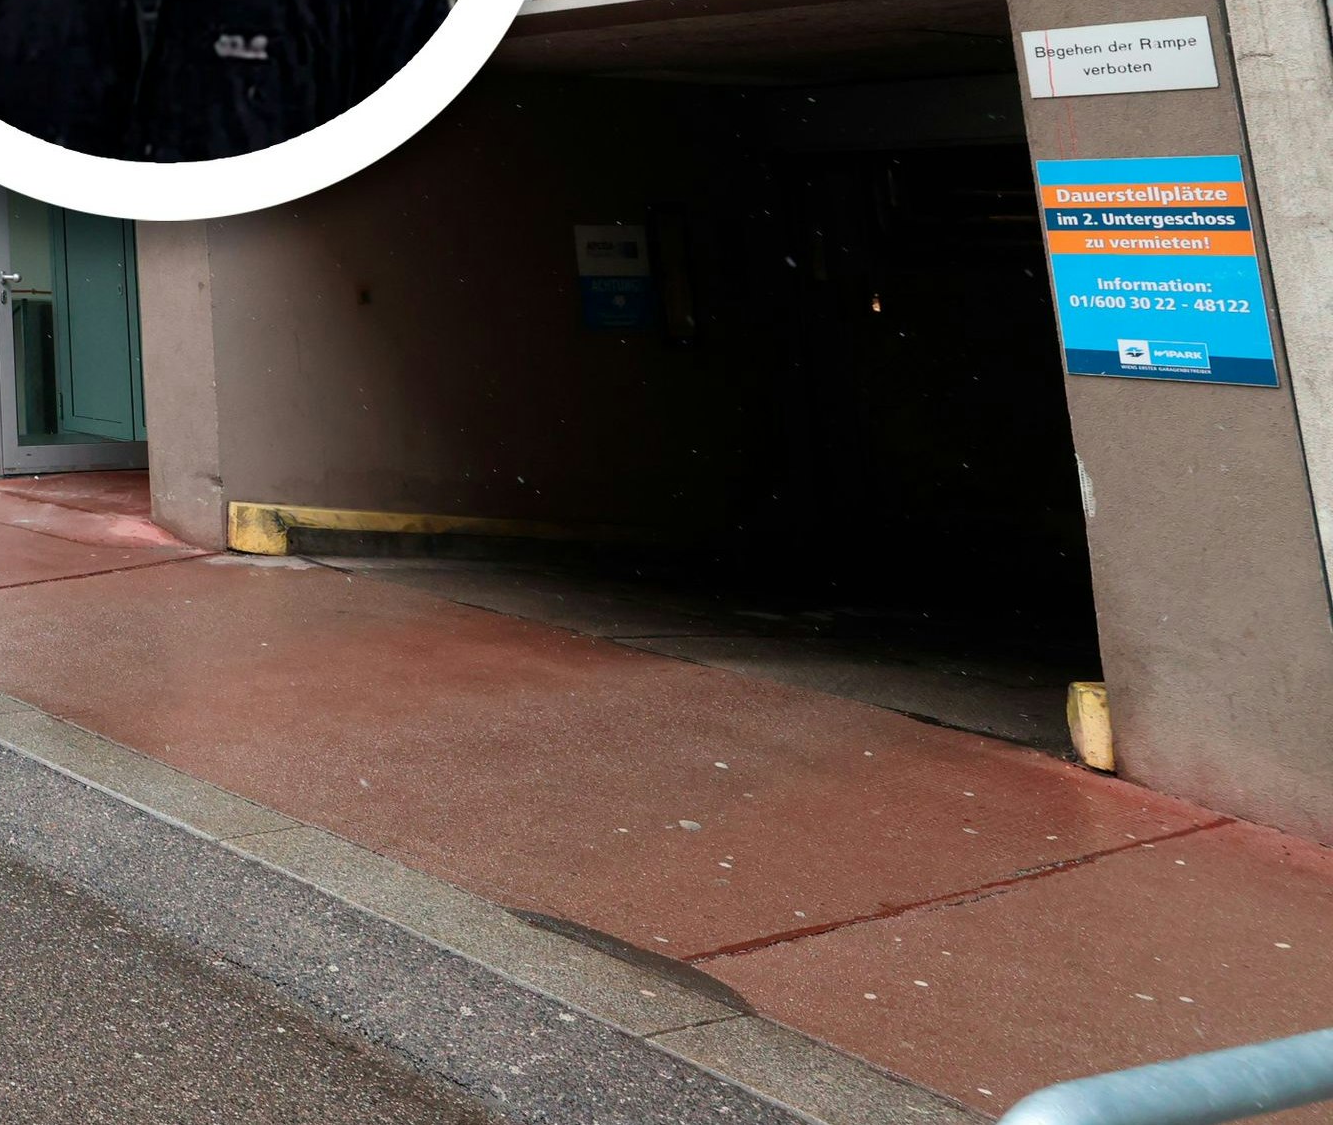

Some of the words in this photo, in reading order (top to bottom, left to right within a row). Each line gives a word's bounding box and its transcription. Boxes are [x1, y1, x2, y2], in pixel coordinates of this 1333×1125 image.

[1035, 43, 1102, 60] Begehen
[1108, 40, 1133, 53] der
[1139, 37, 1197, 51] Rampe
[1083, 62, 1152, 76] verboten
[1056, 187, 1228, 205] Dauerstellplätze
[1057, 212, 1078, 225] im
[1083, 213, 1098, 225] 2.
[1102, 212, 1236, 228] Untergeschoss
[1085, 237, 1104, 248] zu
[1109, 236, 1210, 249] vermieten!
[1097, 277, 1212, 293] Information:
[1069, 294, 1126, 309] 01/600
[1130, 296, 1151, 310] 30
[1155, 297, 1176, 311] 22
[1193, 298, 1251, 313] 48122
